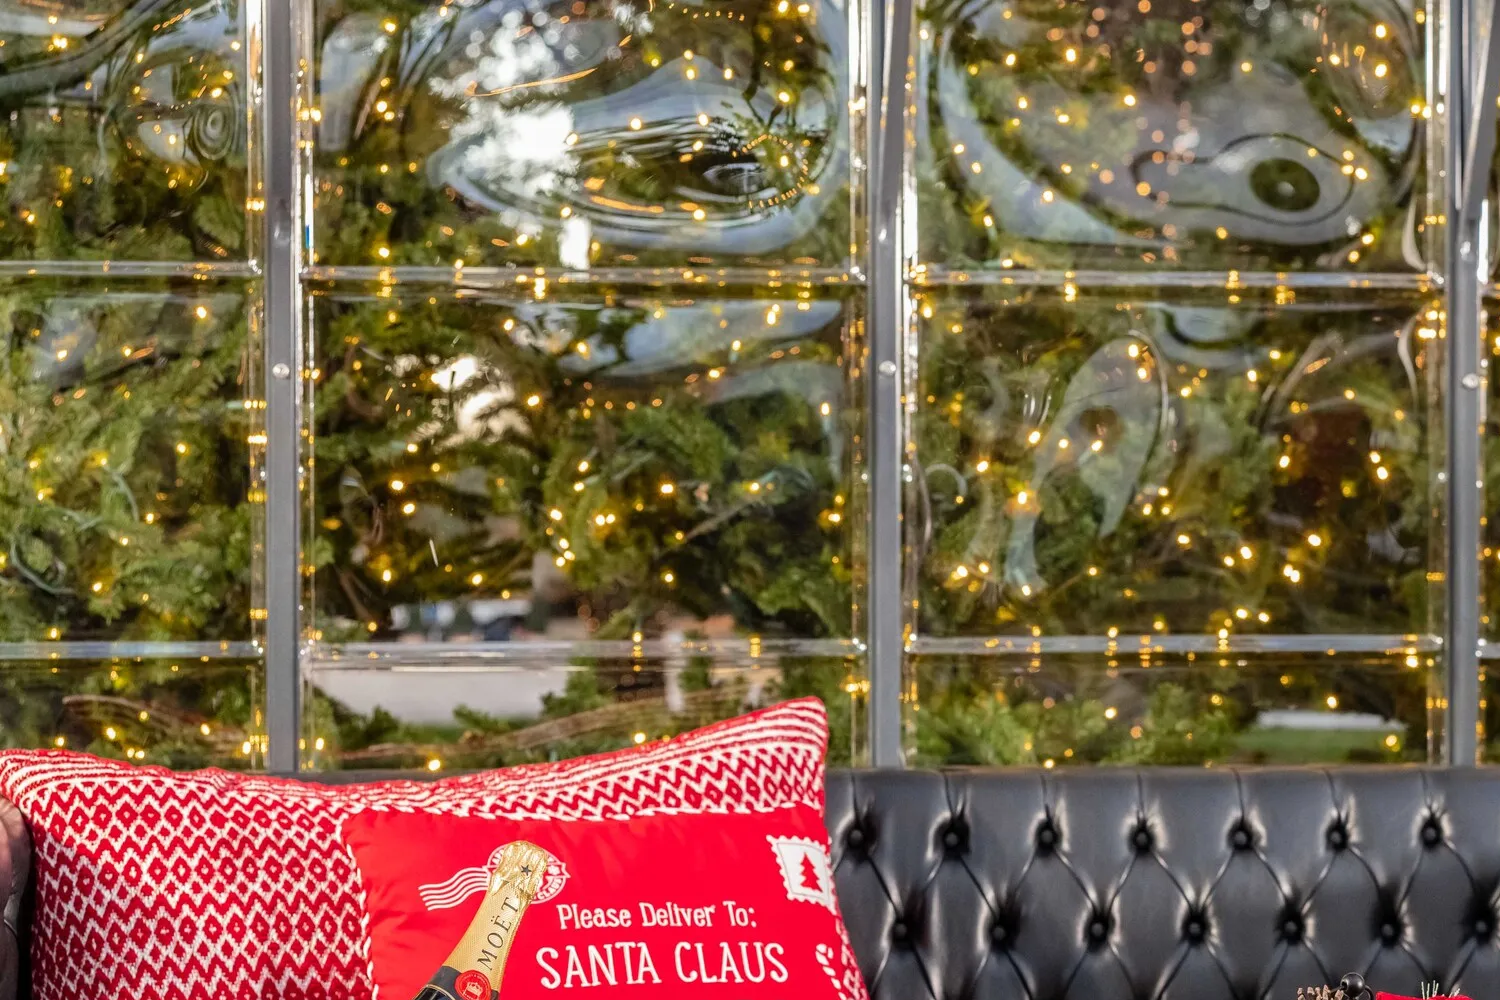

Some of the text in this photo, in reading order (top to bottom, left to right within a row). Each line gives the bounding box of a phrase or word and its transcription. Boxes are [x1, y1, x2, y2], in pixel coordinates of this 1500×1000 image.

[477, 896, 519, 971] MOËT
[556, 901, 757, 930] Please Deliver To:
[535, 941, 789, 990] SANTA CLAUS
